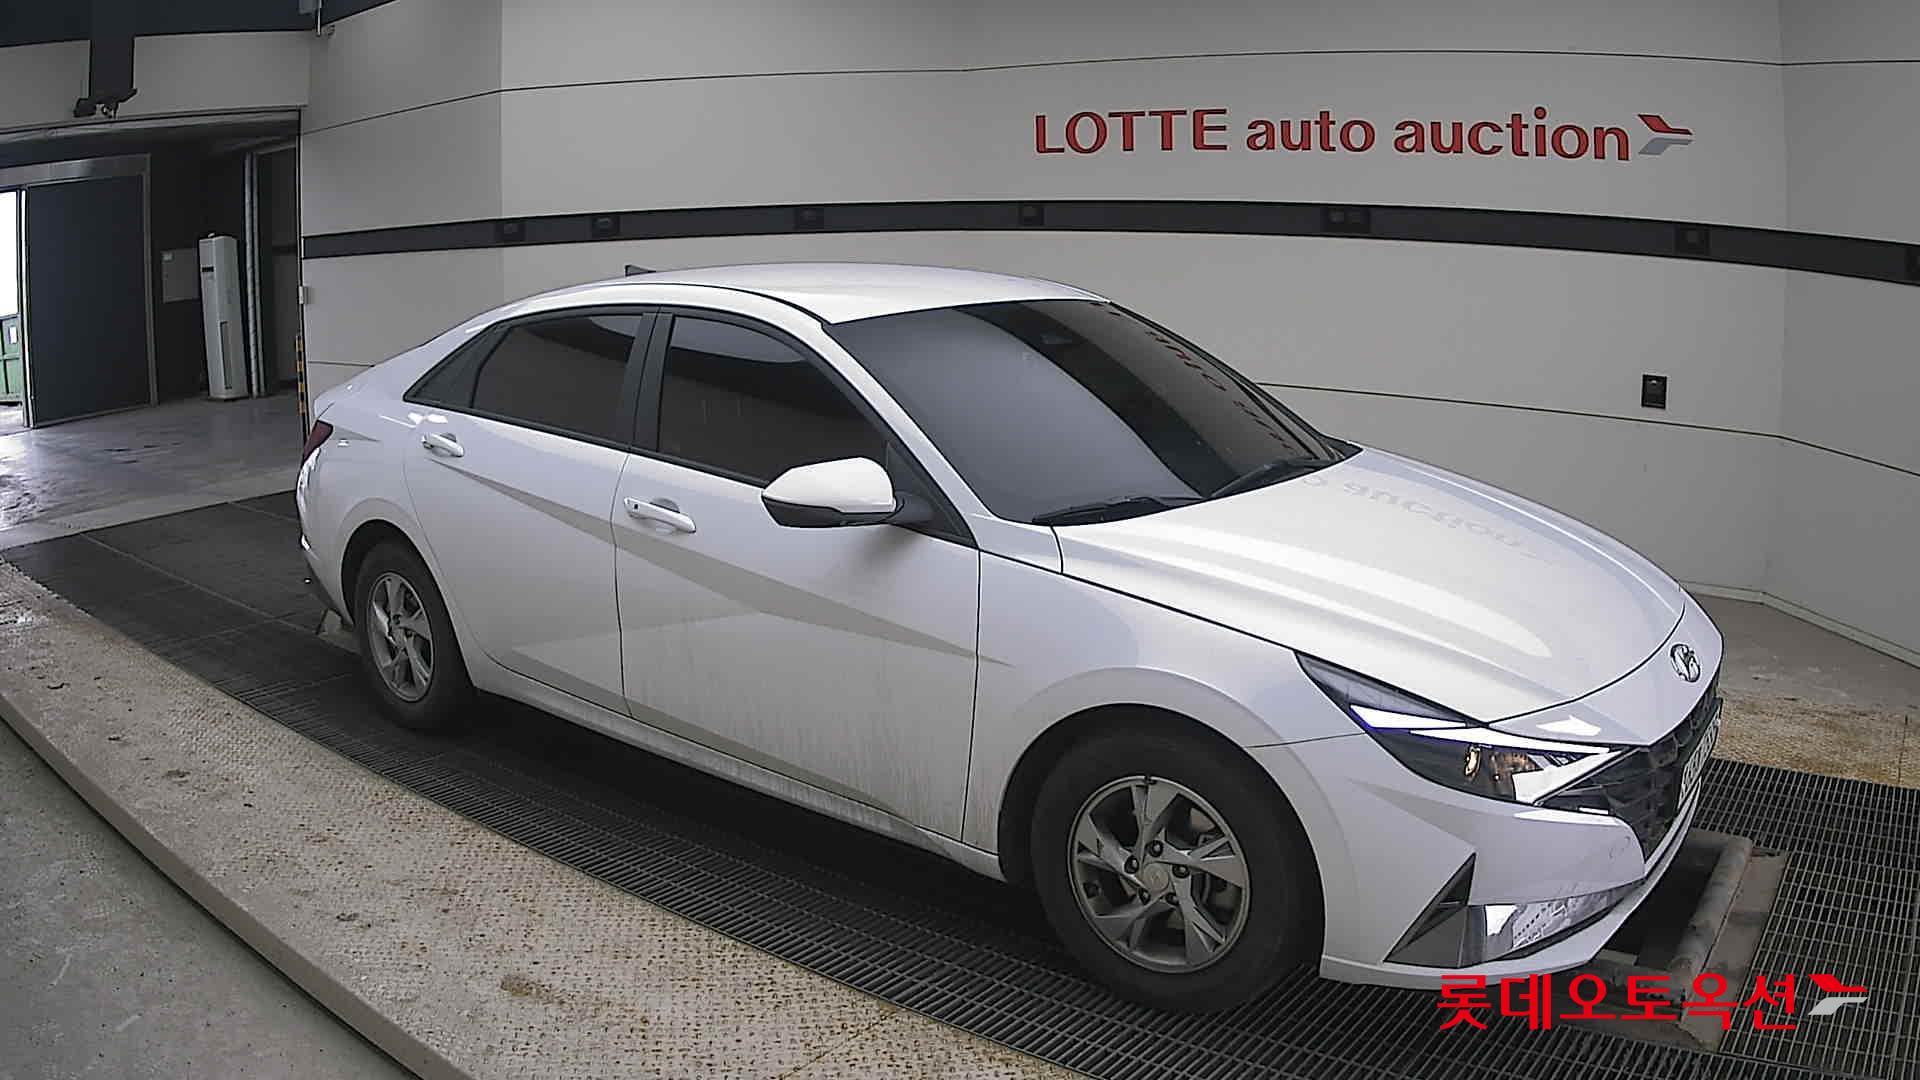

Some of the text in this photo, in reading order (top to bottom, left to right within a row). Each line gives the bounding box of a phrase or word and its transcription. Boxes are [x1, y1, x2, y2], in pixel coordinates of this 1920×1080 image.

[1035, 107, 1630, 161] LOTTE auto auction
